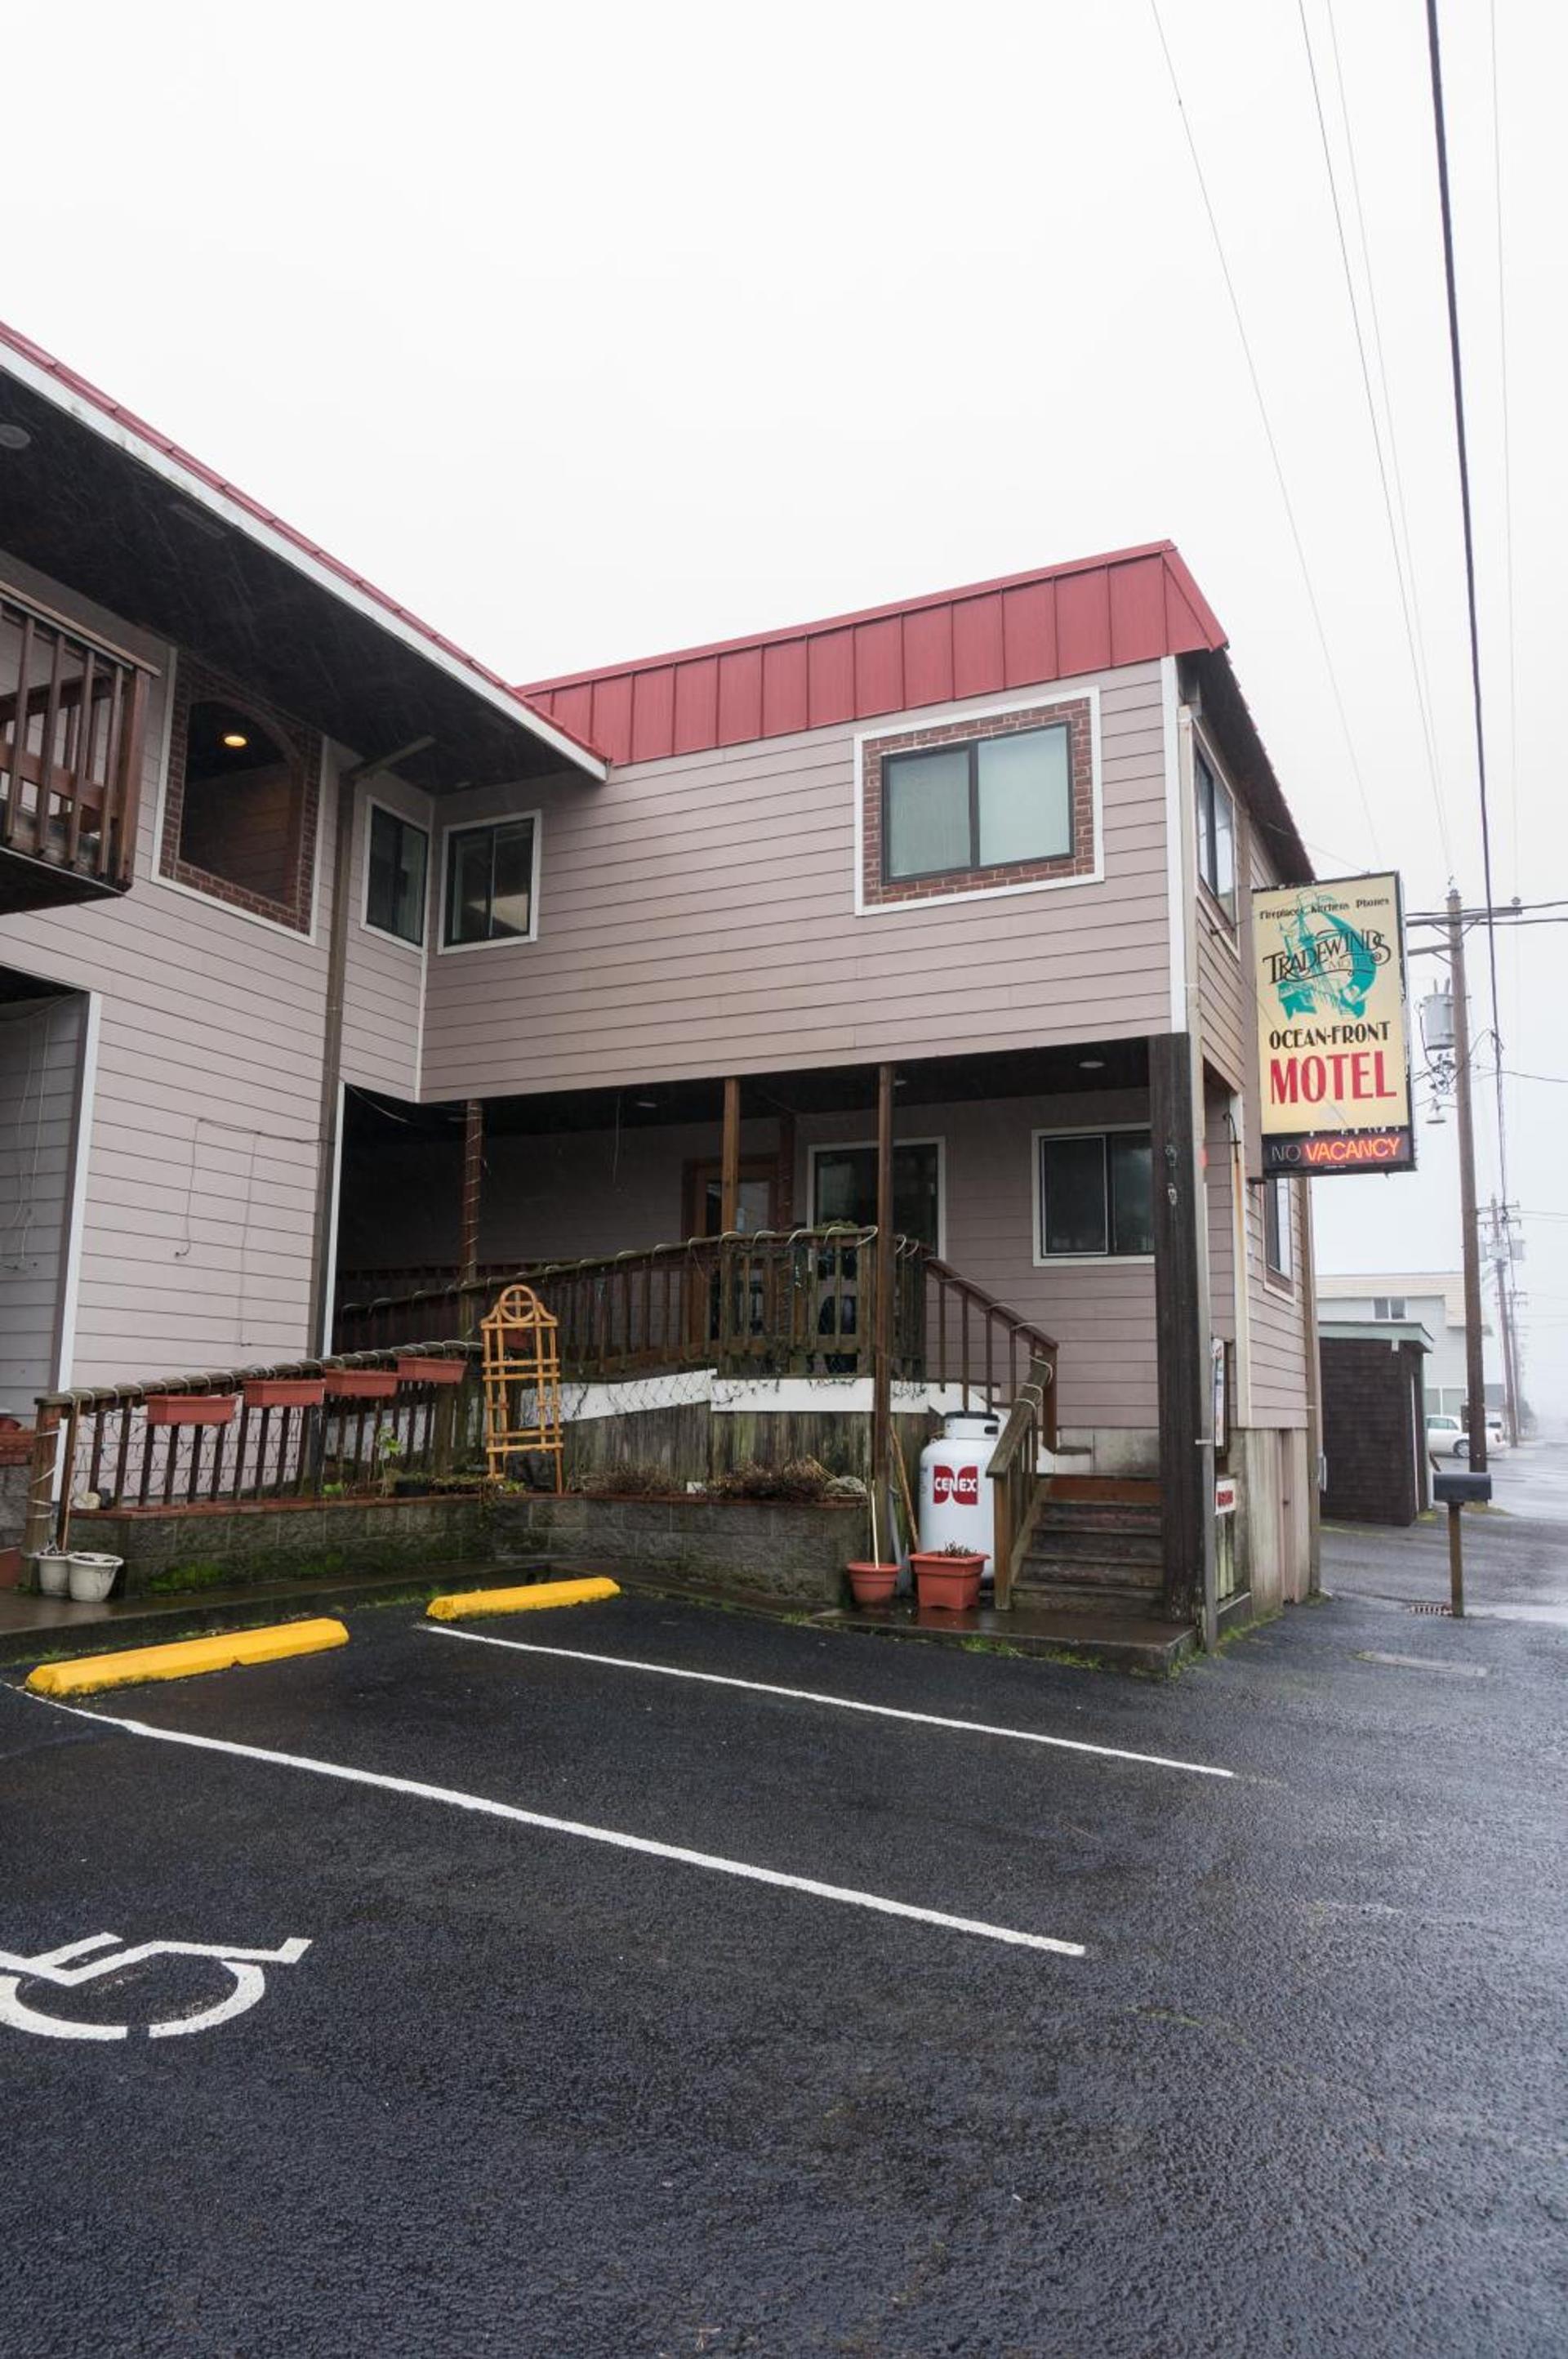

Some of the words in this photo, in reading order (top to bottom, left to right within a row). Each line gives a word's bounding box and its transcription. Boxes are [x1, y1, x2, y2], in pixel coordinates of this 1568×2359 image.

[1356, 898, 1389, 908] Phones
[1262, 928, 1392, 983] TRADEWINDS
[1269, 1021, 1391, 1050] OCEAN-FRONT
[1270, 1050, 1397, 1105] MOTEL
[1272, 1144, 1301, 1162] NO
[1305, 1137, 1400, 1162] VACANCY
[935, 1478, 977, 1492] CENEX
